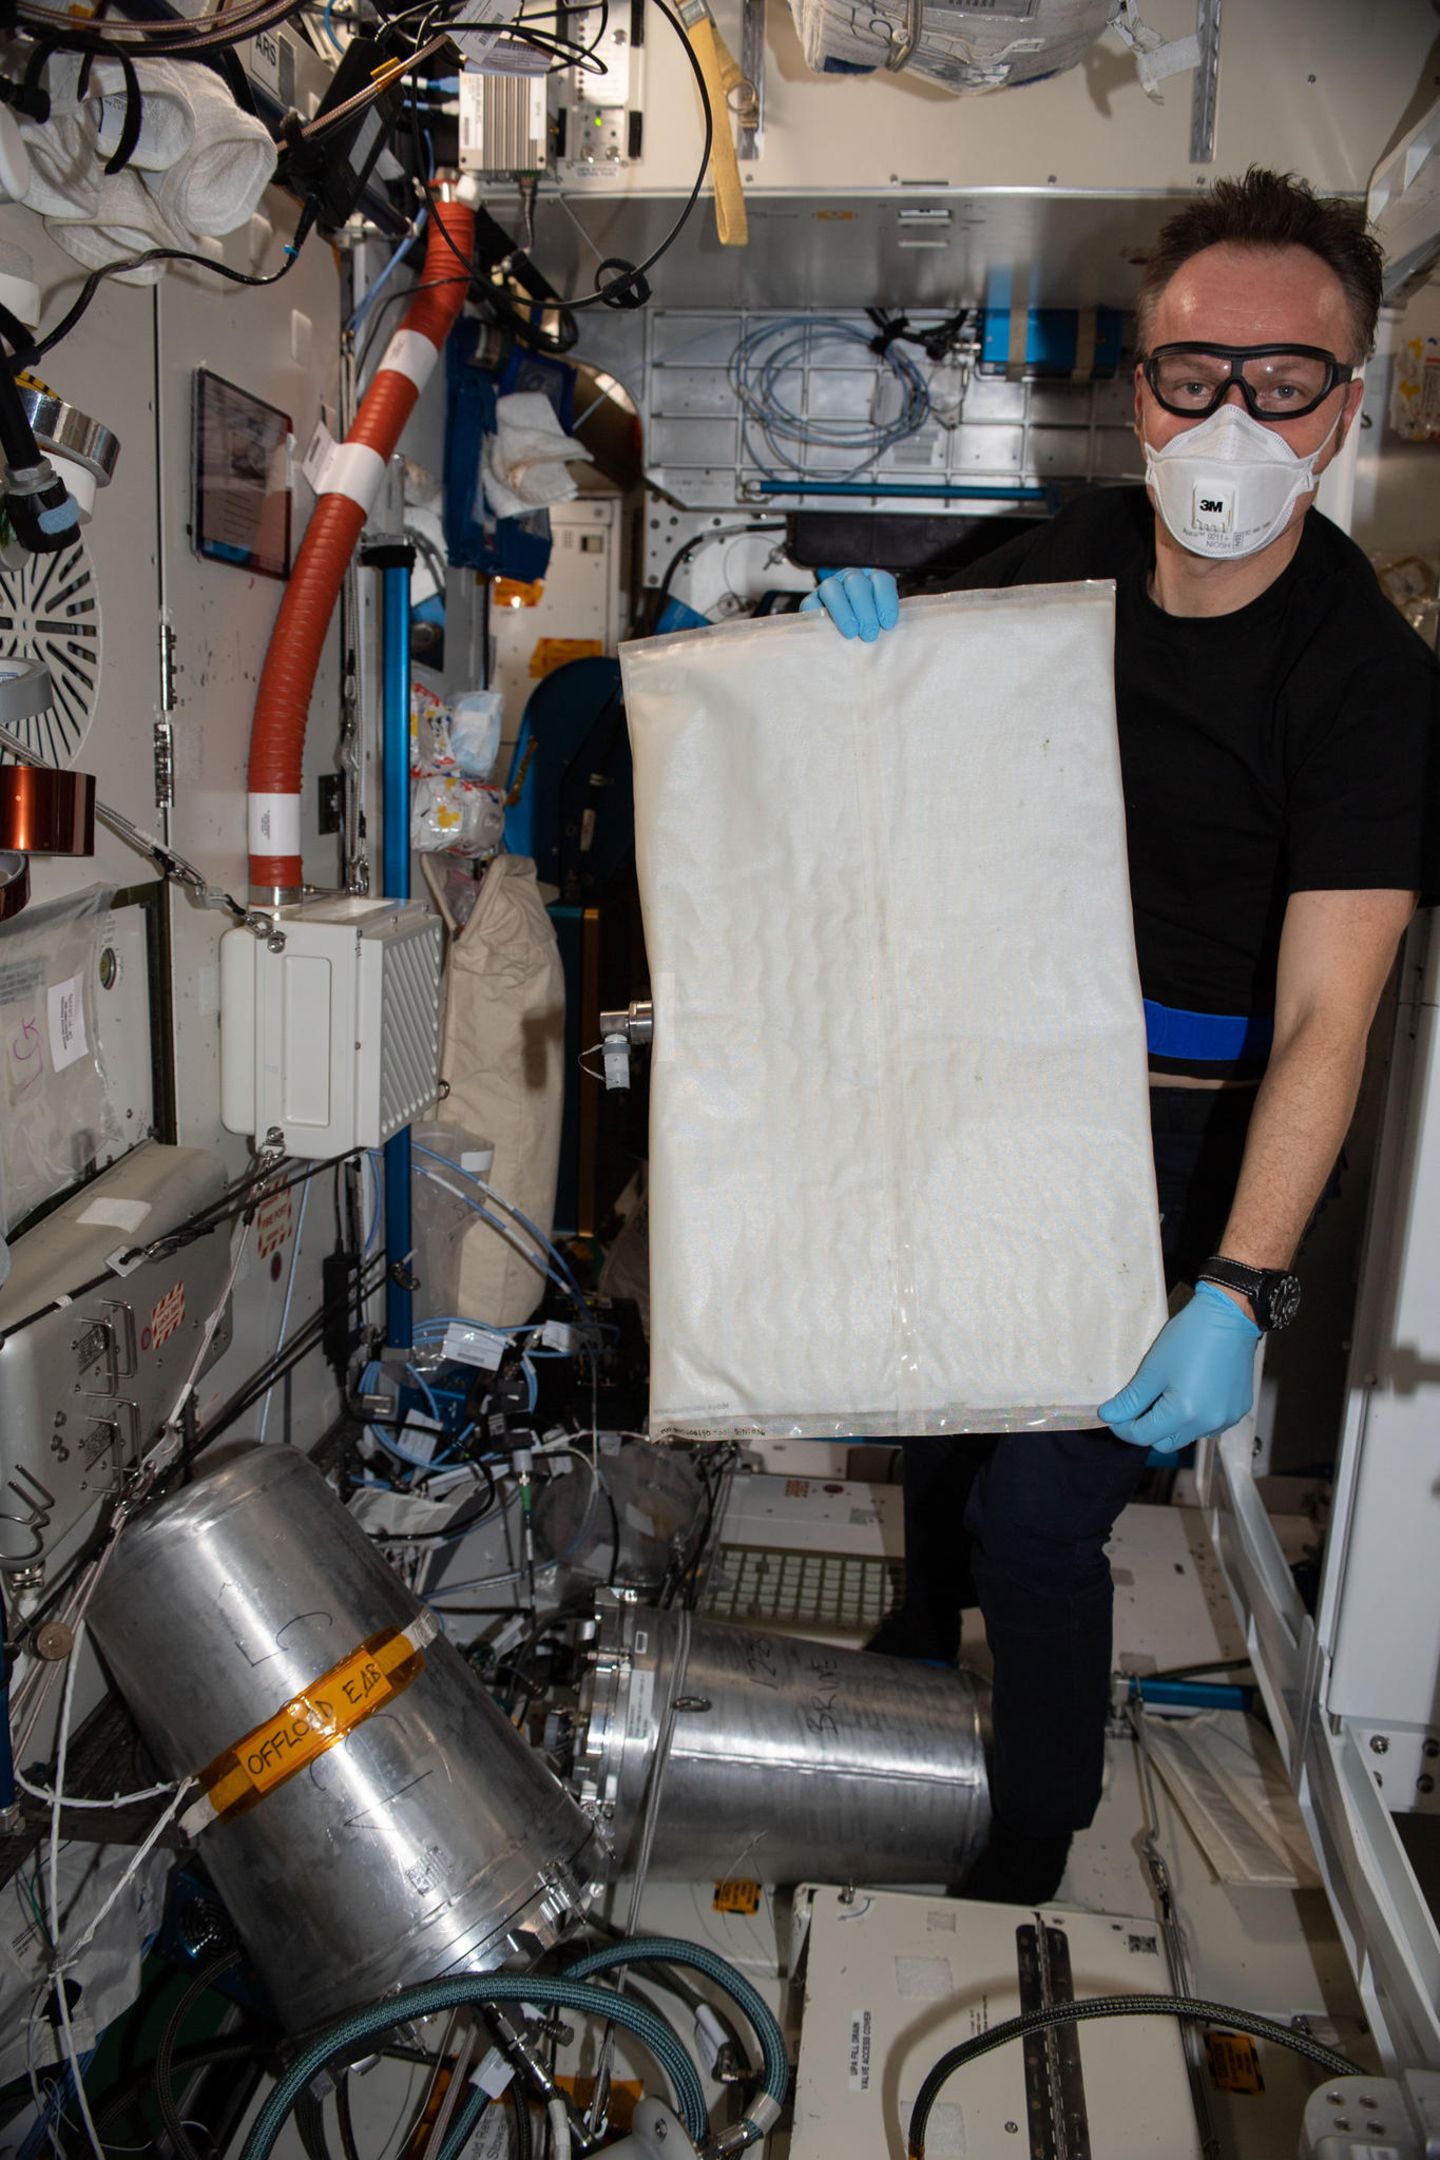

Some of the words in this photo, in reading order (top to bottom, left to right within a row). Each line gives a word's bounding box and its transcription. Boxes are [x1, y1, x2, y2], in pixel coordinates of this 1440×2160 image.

[256, 35, 277, 66] ARS
[1200, 500, 1223, 513] 3M
[248, 1700, 334, 1775] OFFLOAD
[852, 2022, 860, 2043] DRAIN
[863, 2011, 872, 2034] COVER
[851, 2045, 859, 2060] FILL
[862, 2037, 871, 2064] ACCESS
[861, 2066, 870, 2089] VALVE
